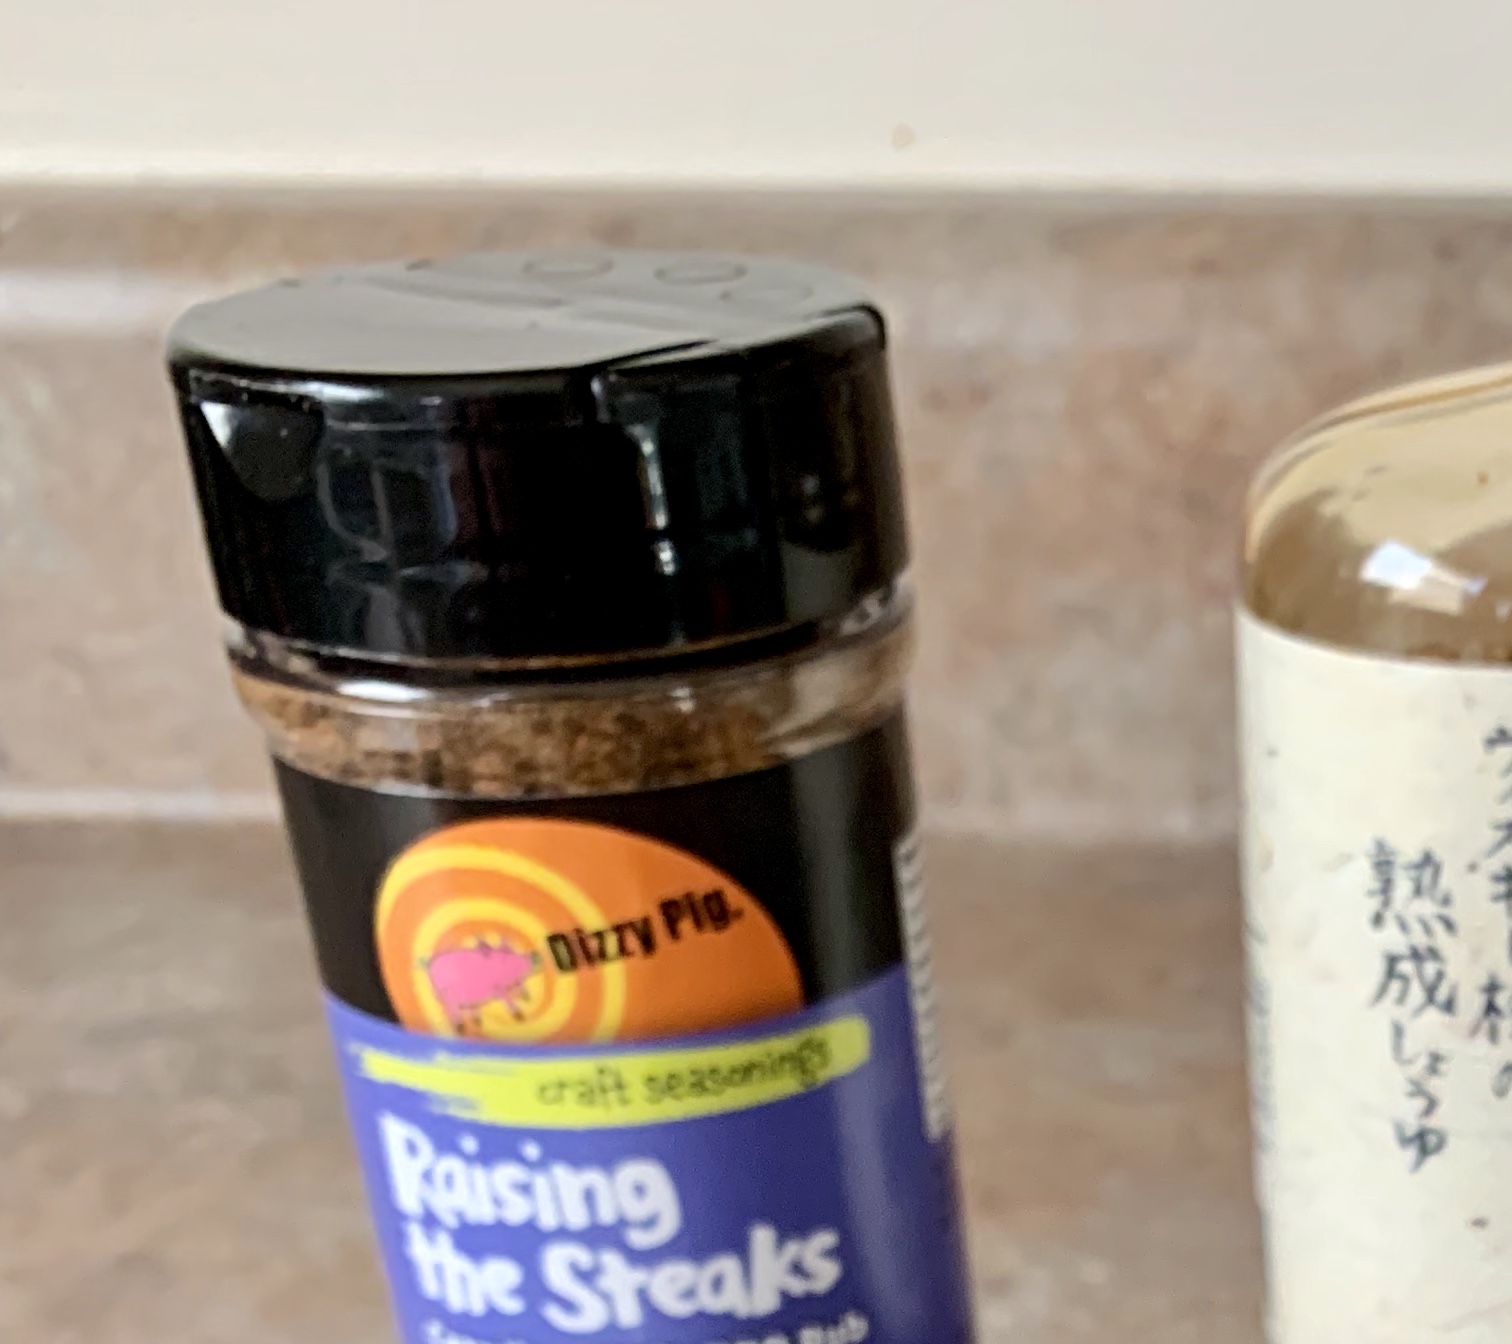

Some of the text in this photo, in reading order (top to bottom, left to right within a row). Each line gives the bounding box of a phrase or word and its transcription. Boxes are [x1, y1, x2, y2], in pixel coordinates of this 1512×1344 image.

[538, 1037, 832, 1107] craft seasonings
[378, 1112, 682, 1250] Raising
[406, 1220, 842, 1334] the Steaks
